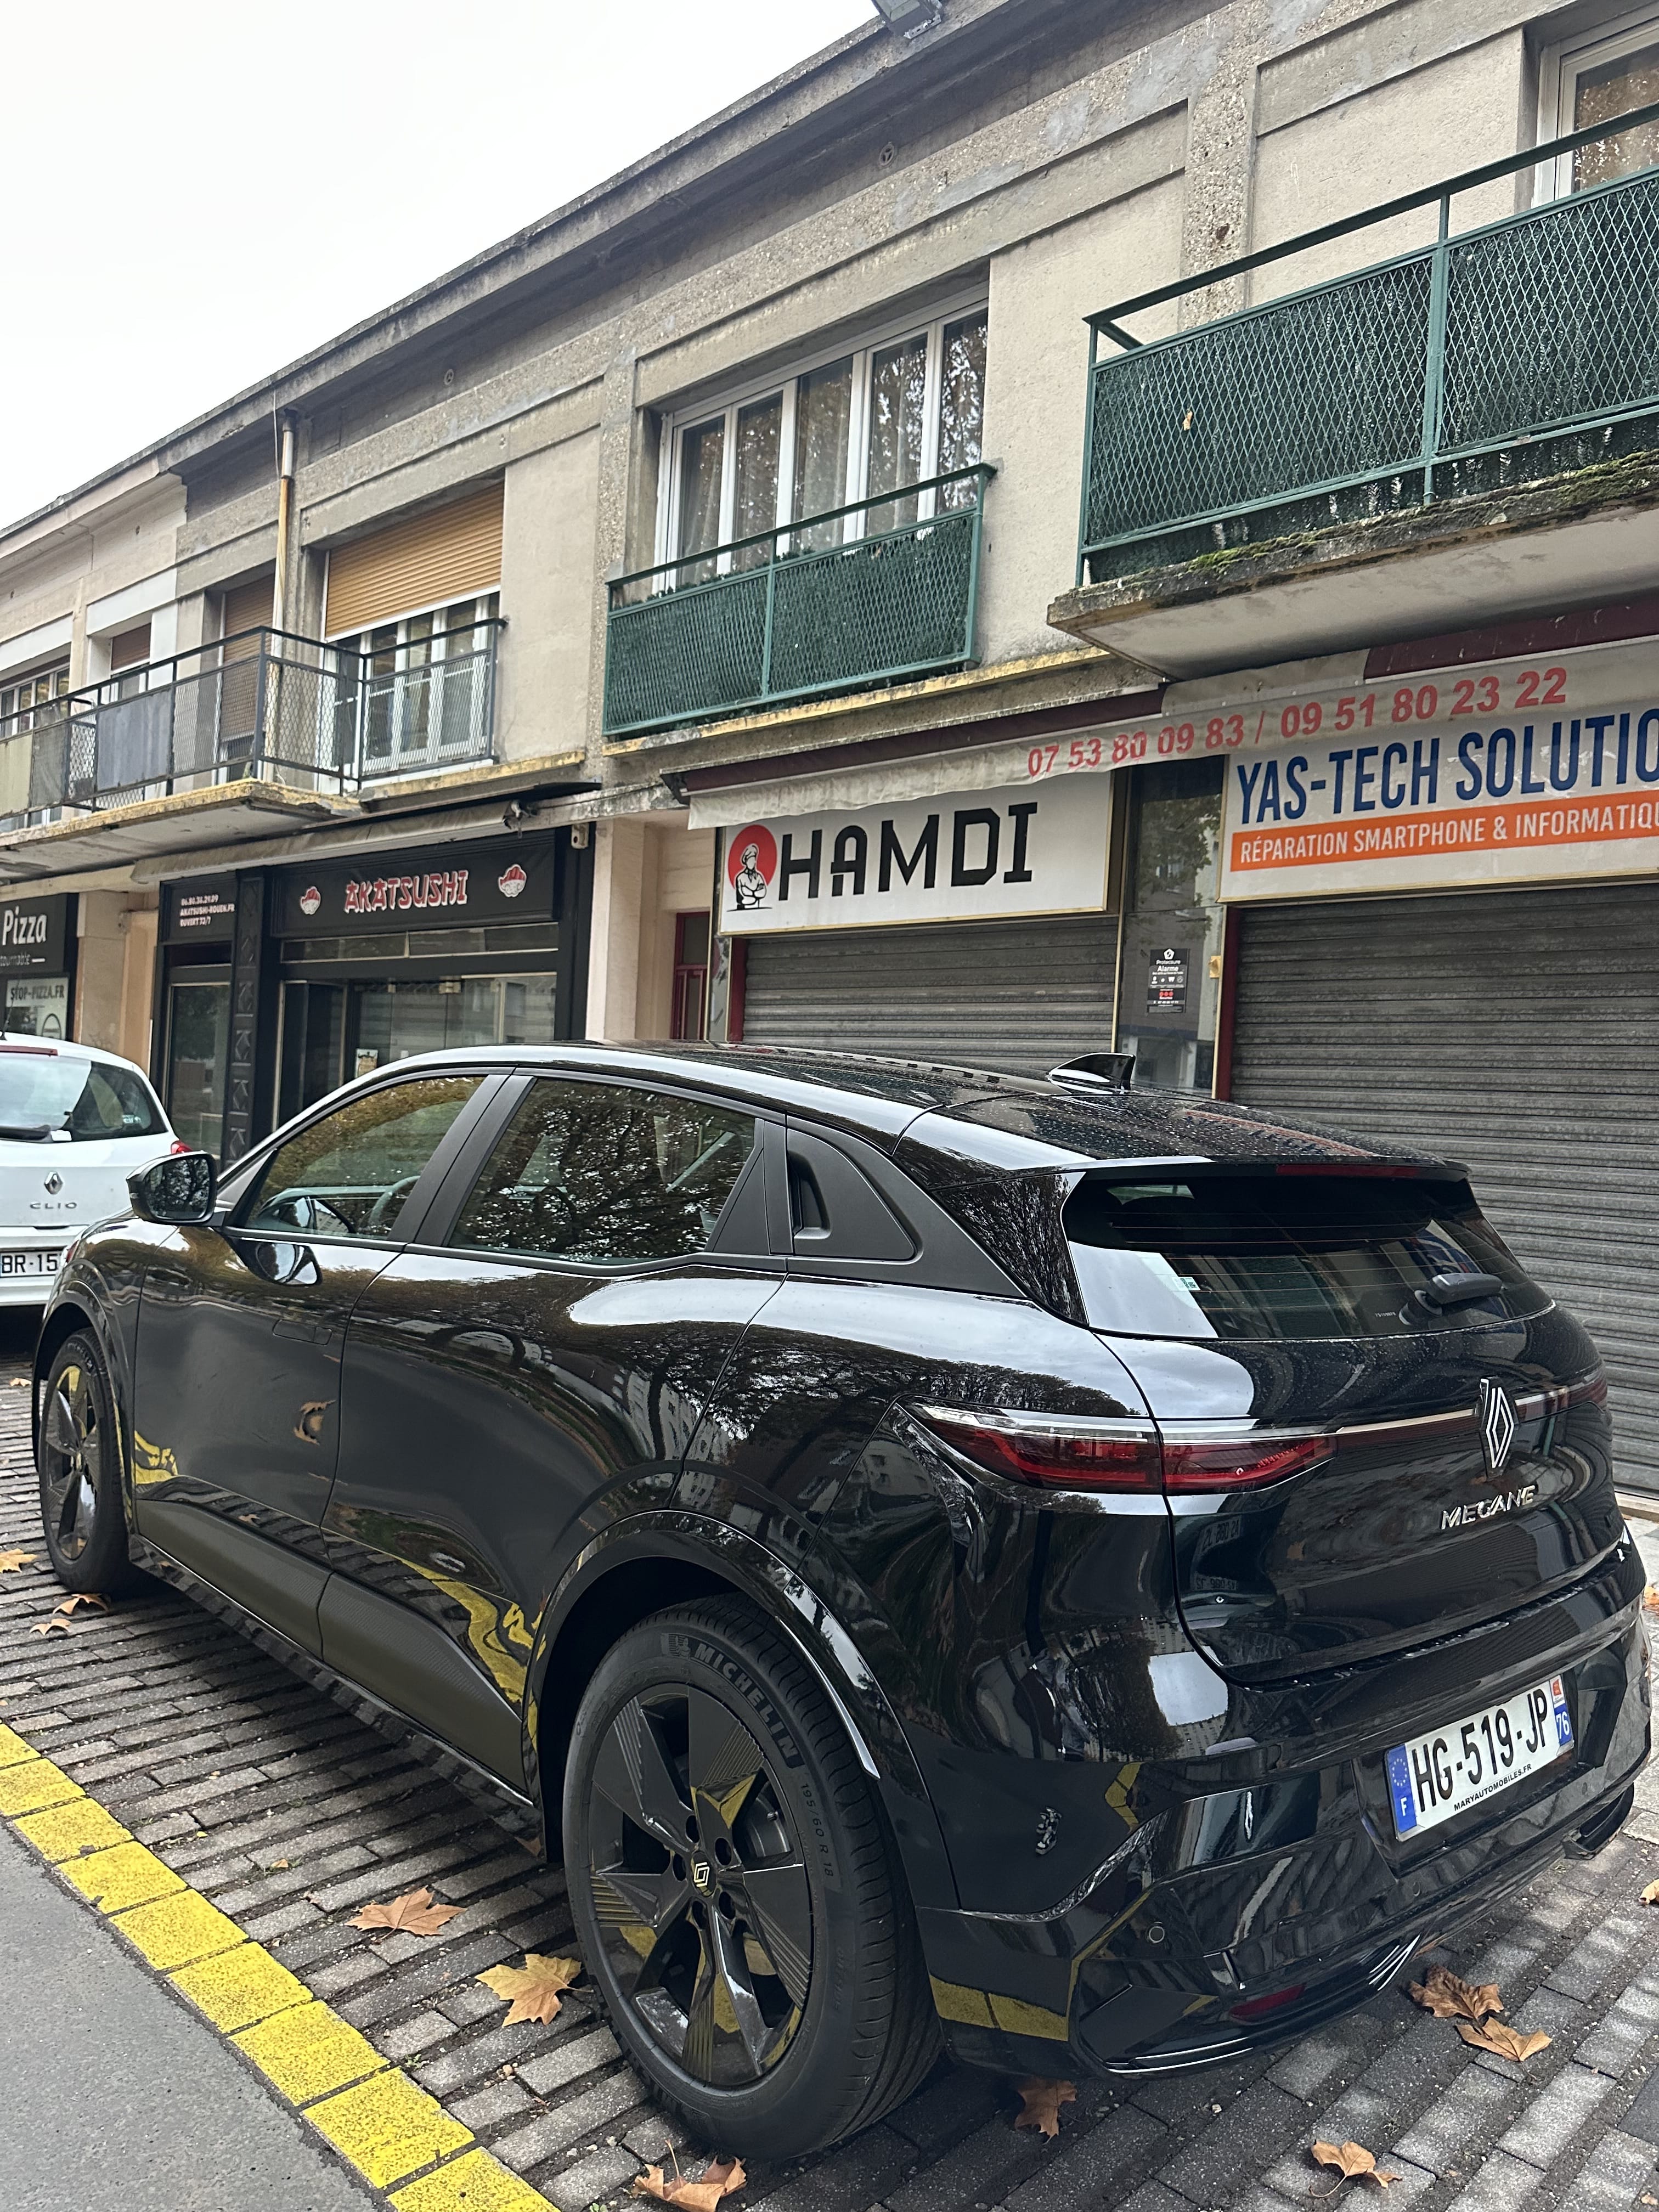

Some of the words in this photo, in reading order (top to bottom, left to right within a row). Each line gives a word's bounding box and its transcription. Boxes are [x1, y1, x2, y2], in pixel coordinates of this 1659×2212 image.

[1028, 745, 1059, 776] 07
[1068, 738, 1101, 769] 53
[1111, 731, 1147, 764] 80
[1158, 723, 1194, 757] 09
[1205, 714, 1244, 749] 83
[1280, 702, 1322, 738] 09
[1334, 694, 1376, 731] 51
[1391, 684, 1437, 723] 80
[1450, 676, 1499, 715] 23
[1514, 667, 1567, 708] 22
[1237, 737, 1440, 825] YAS-TECH
[778, 802, 1038, 901] HAMDI
[1240, 832, 1348, 864] RÉPARATION
[1353, 817, 1486, 853] SMARTPHONE
[1492, 815, 1508, 840] &
[343, 870, 469, 913] AKATSUSHI
[2, 905, 47, 946] Pizza
[180, 917, 199, 927] OUVERT
[10, 985, 64, 1000] STOP-PIZZA.FR
[30, 1201, 77, 1210] CLIO
[1, 1253, 62, 1273] BR-15
[1440, 1485, 1536, 1530] MEGANE
[694, 1643, 799, 1759] MICHELIN
[1555, 1711, 1570, 1739] 76
[1412, 1689, 1548, 1813] HG-519-JP
[1401, 1797, 1407, 1816] F
[1454, 1763, 1532, 1811] MARYAUTOMOBILES.FR
[800, 1783, 825, 1837] 195/60
[819, 1843, 829, 1854] R
[823, 1862, 834, 1877] 18
